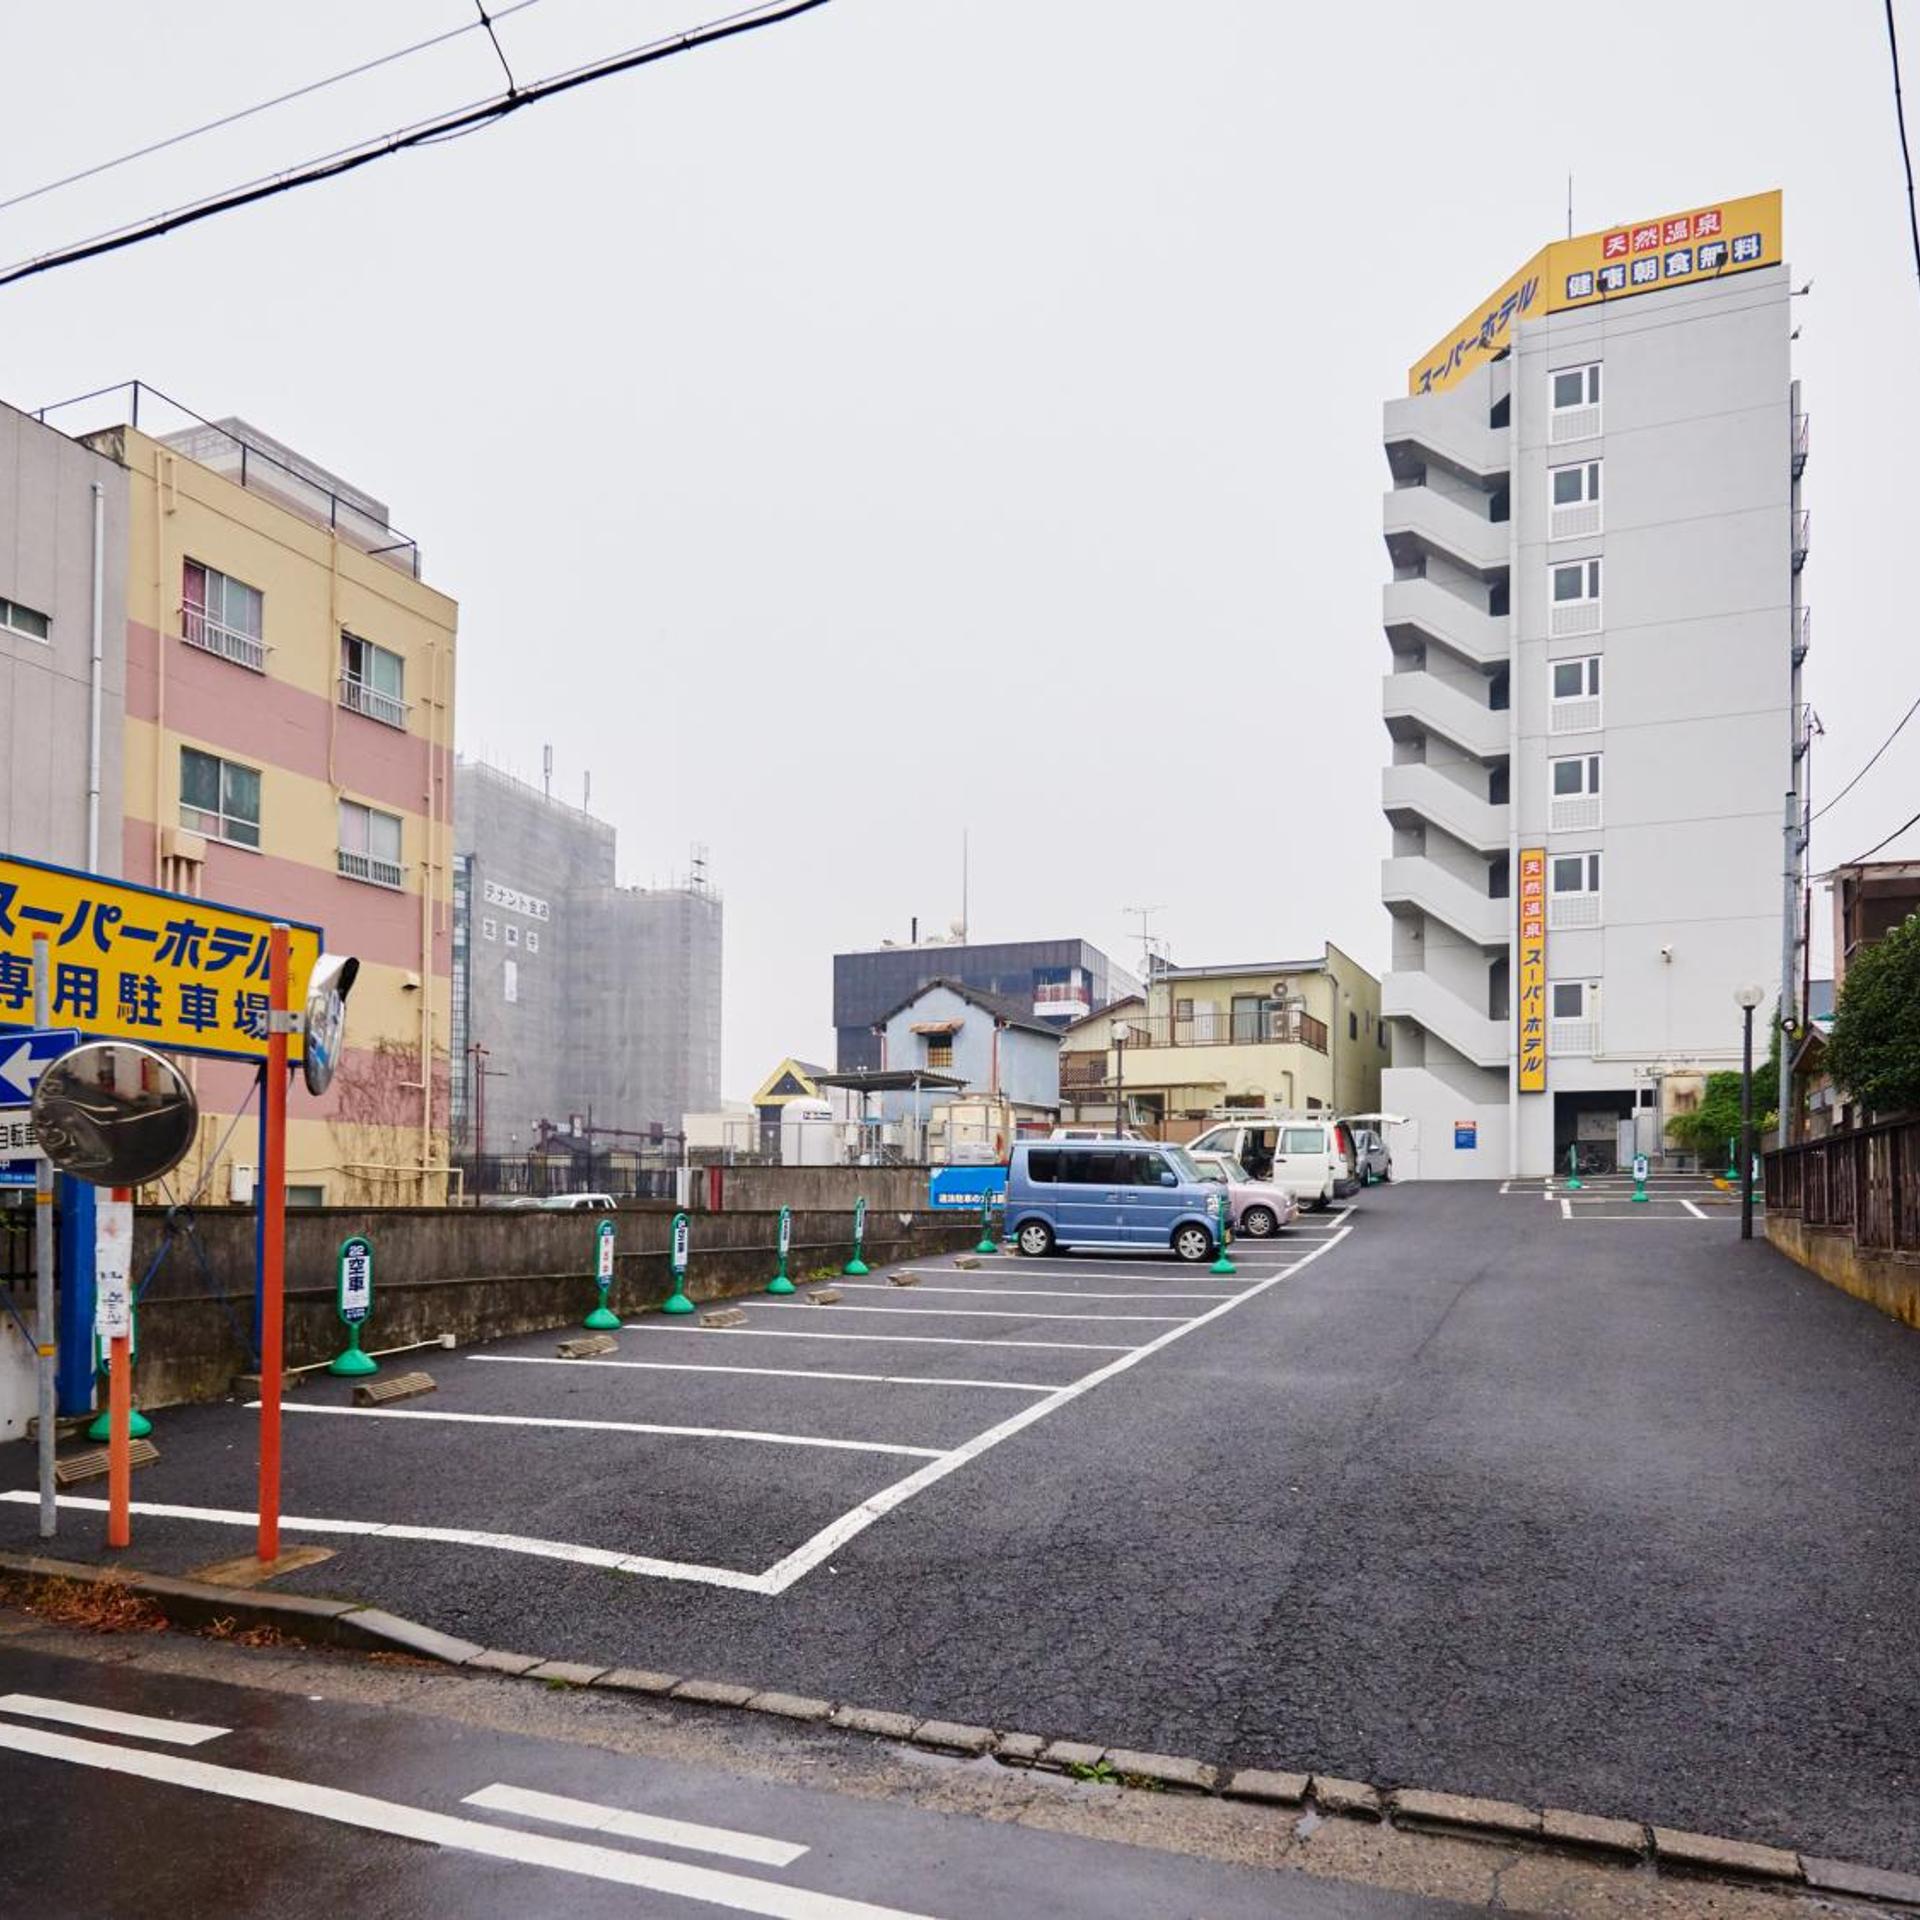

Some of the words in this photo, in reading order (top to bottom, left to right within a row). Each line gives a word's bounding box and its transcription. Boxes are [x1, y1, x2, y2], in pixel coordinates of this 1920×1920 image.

[1605, 212, 1721, 257] 天然温泉
[1417, 277, 1538, 393] スーパーホテル
[1523, 860, 1542, 939] 天然温泉
[0, 951, 271, 1041] 専用駐車場
[1523, 950, 1543, 1072] スーパーホテル
[348, 1258, 365, 1292] 空車
